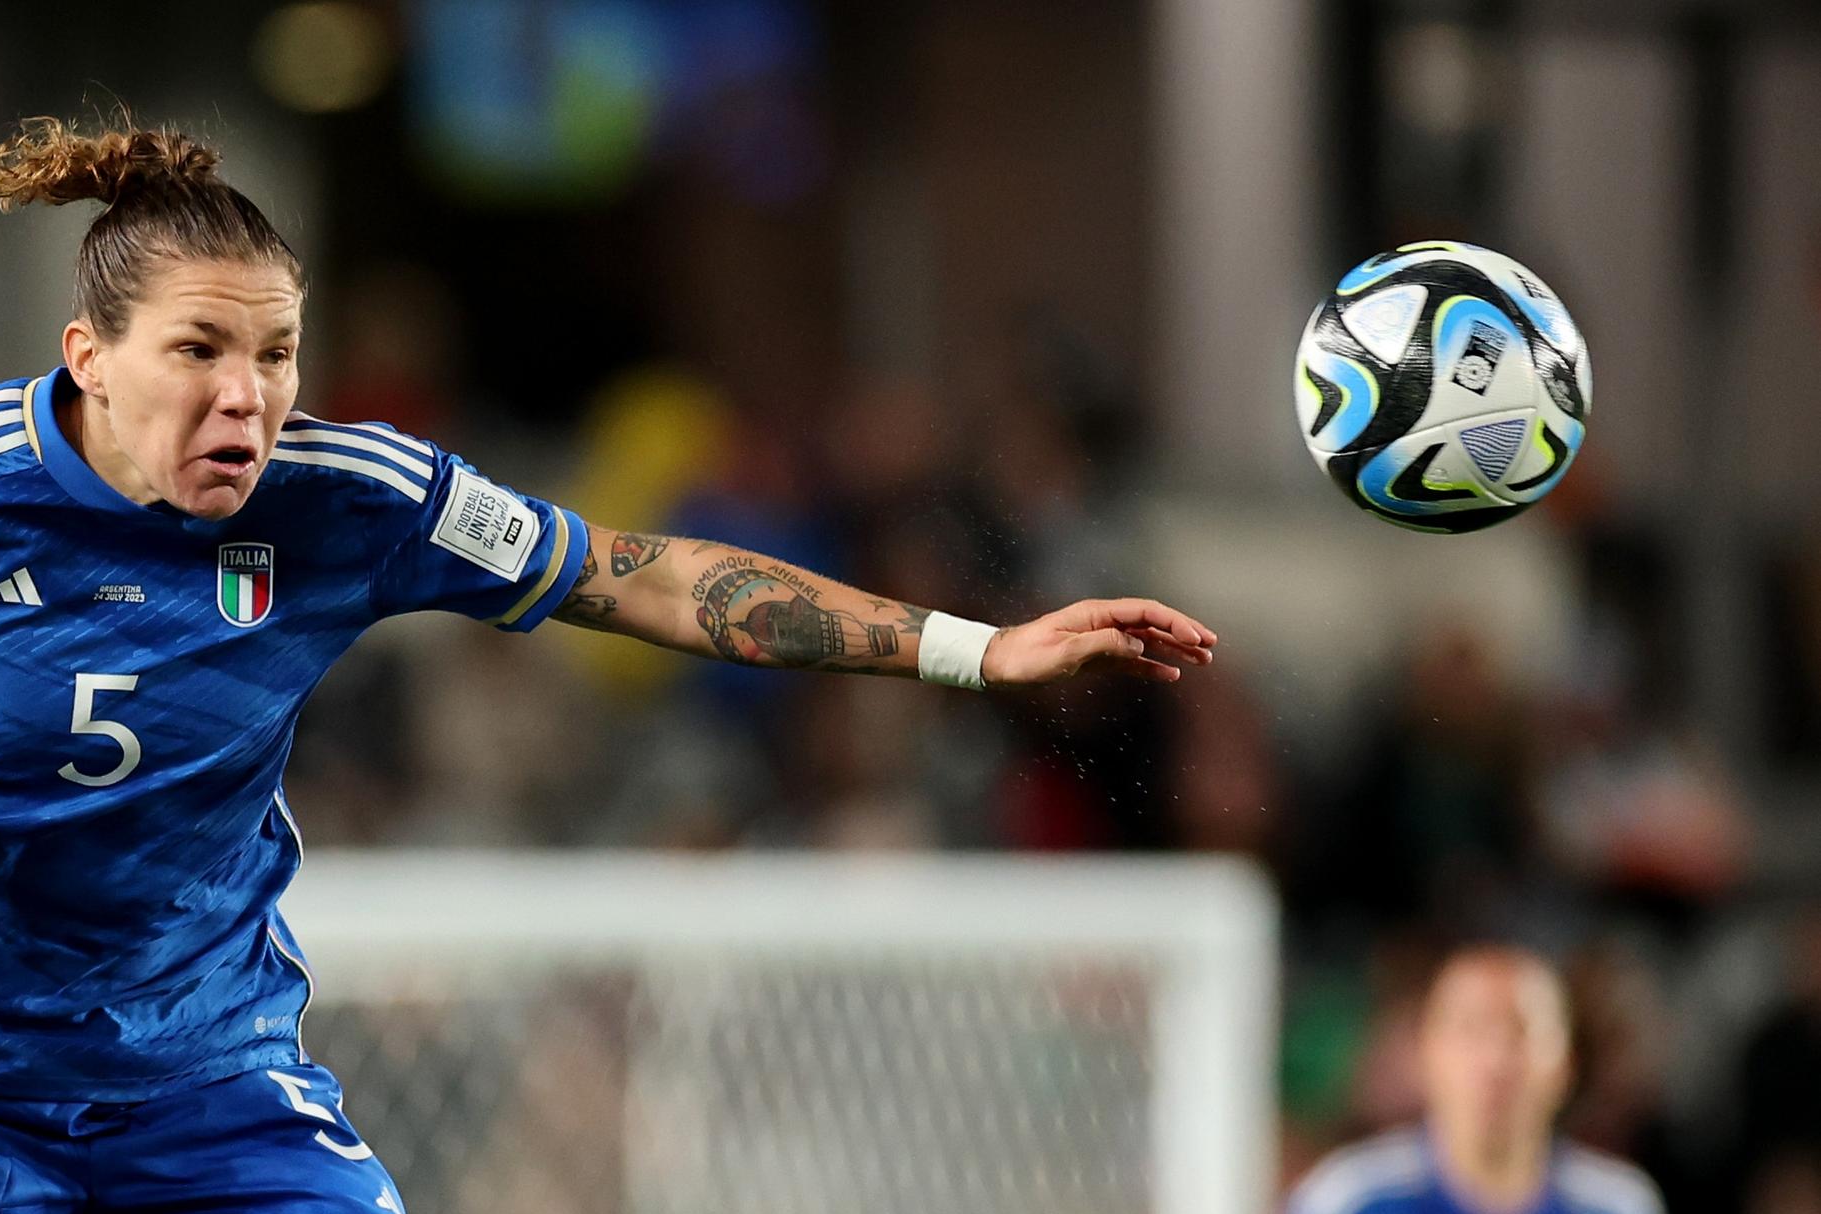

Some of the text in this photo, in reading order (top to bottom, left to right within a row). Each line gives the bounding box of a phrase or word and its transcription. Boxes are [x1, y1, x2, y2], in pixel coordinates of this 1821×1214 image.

[454, 488, 480, 534] FOOTBALL
[466, 492, 496, 541] UNITES
[482, 497, 510, 550] the World
[223, 550, 269, 566] ITALIA
[691, 556, 824, 603] COMUNQUE ANDARE
[99, 584, 142, 593] ARGENTINA
[104, 592, 124, 601] JULY
[124, 593, 146, 603] 2023
[58, 673, 141, 787] 5
[266, 1070, 373, 1161] 5
